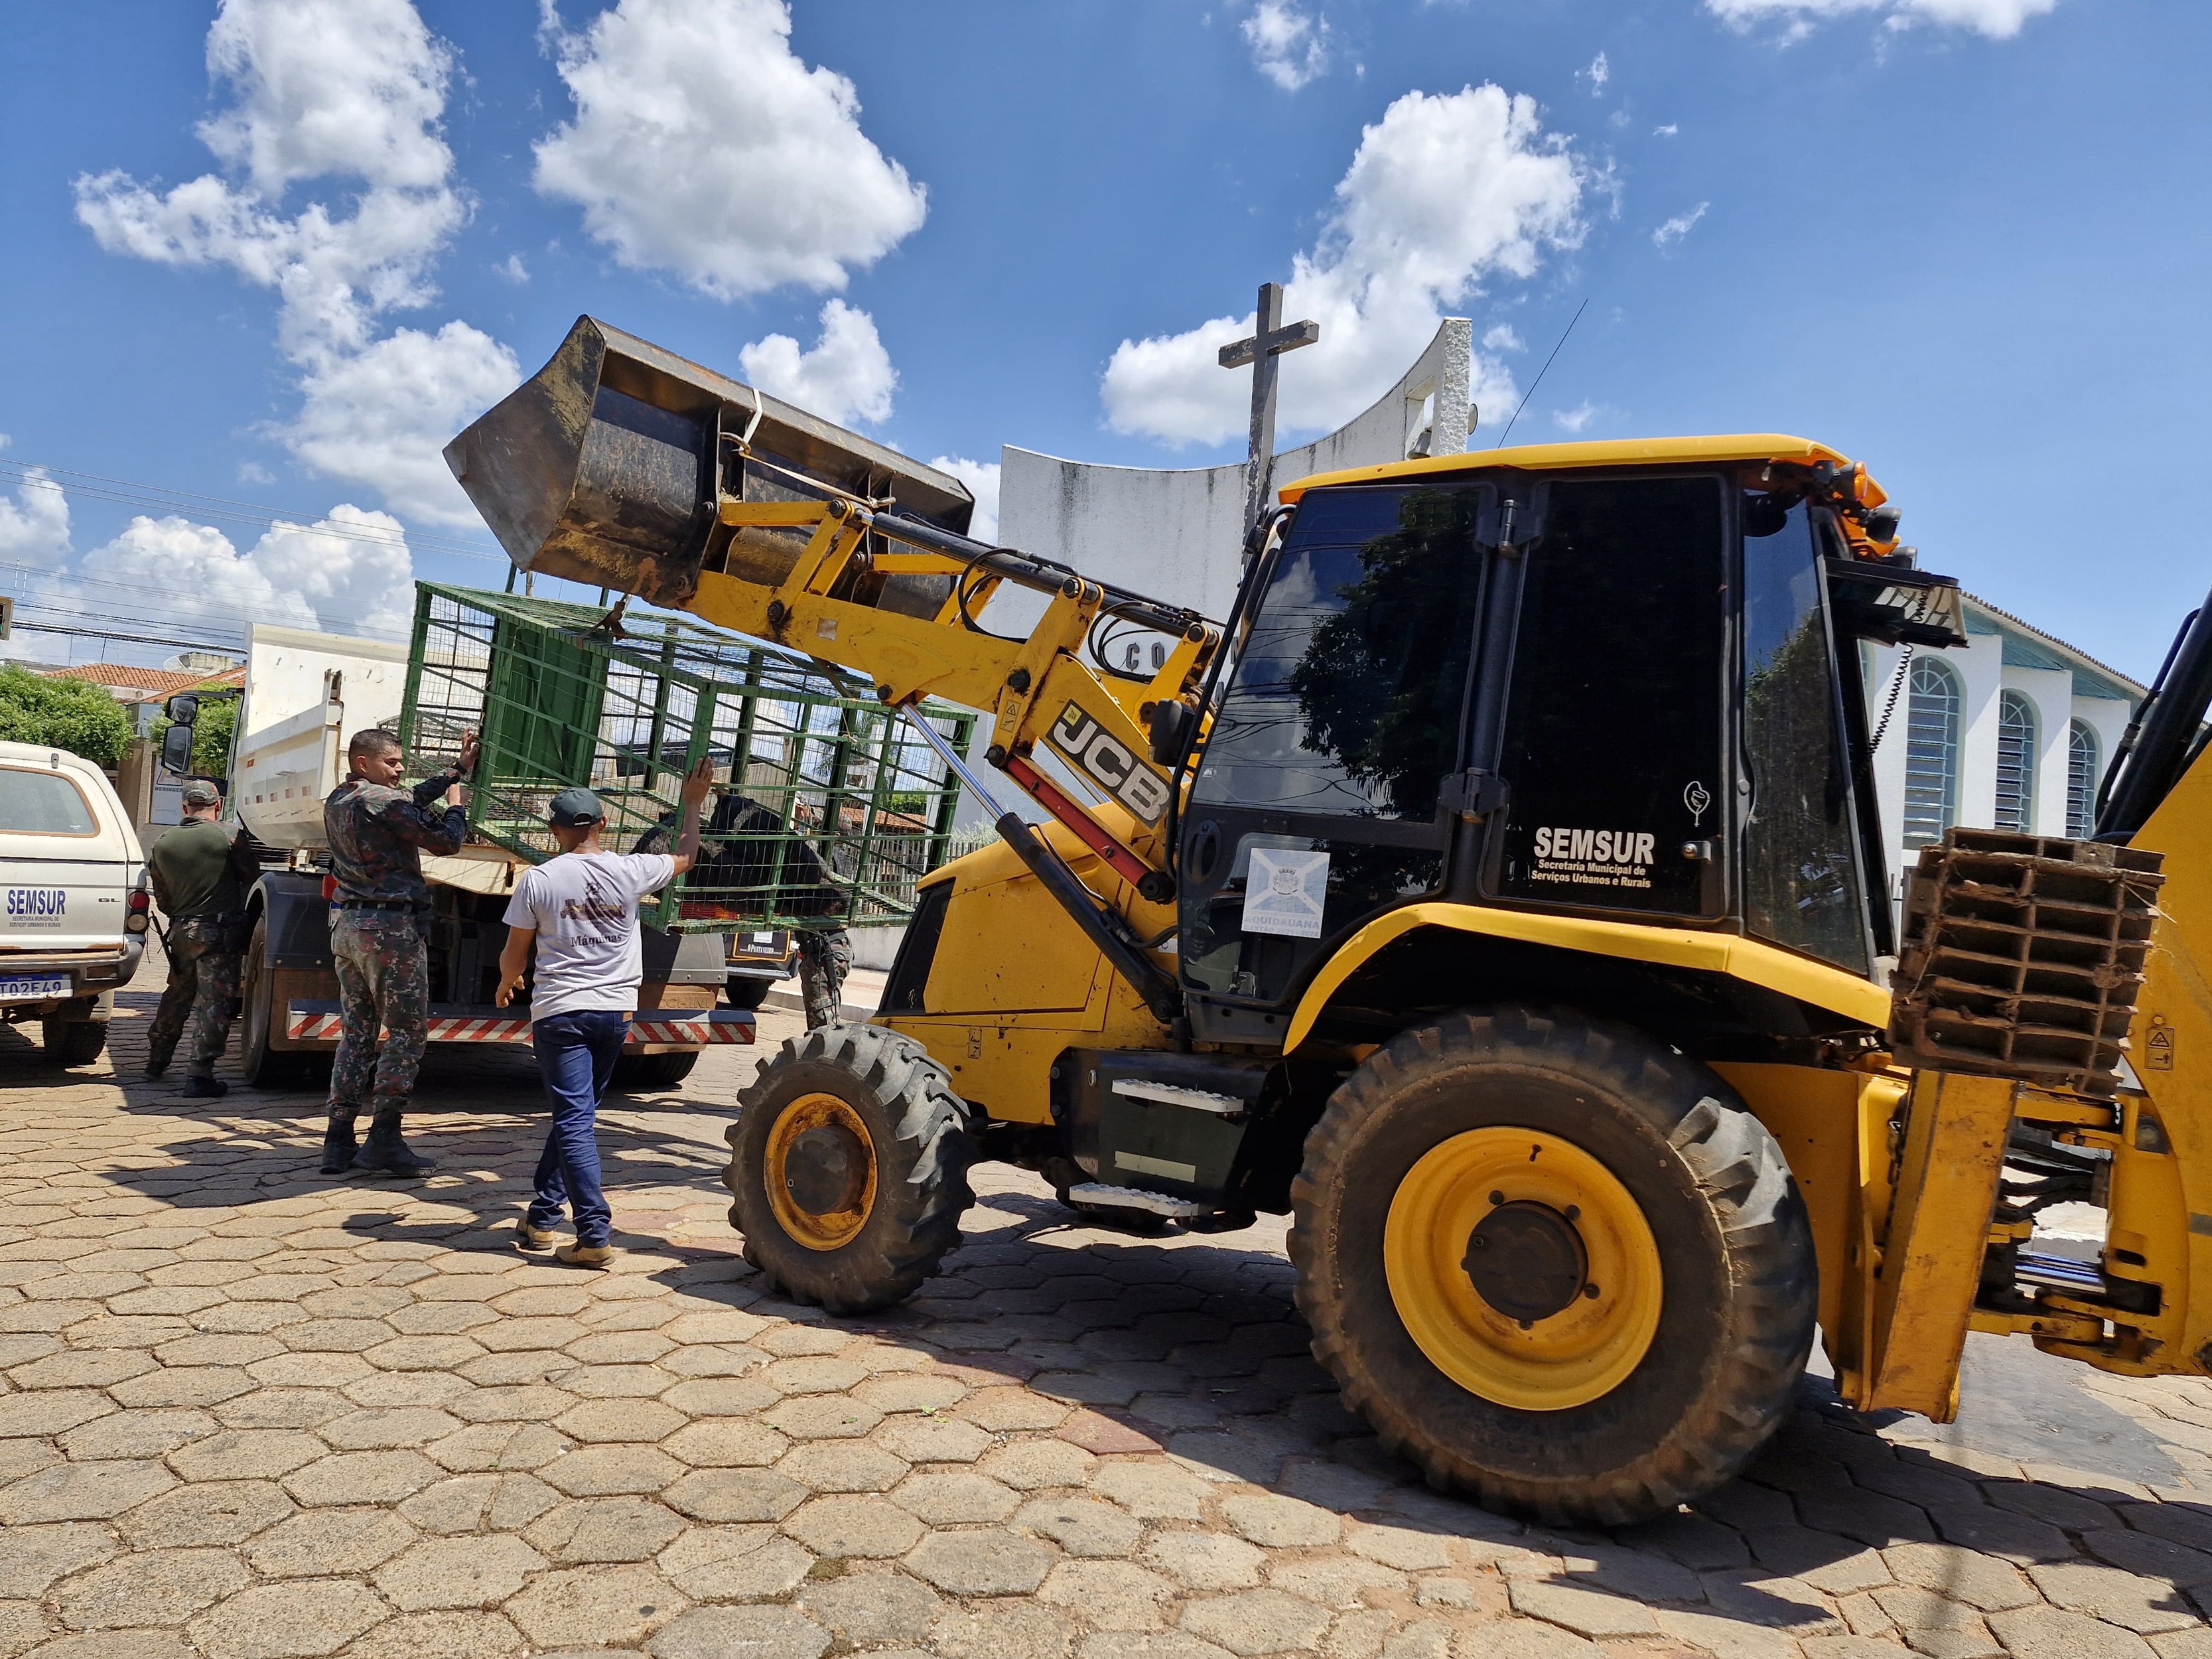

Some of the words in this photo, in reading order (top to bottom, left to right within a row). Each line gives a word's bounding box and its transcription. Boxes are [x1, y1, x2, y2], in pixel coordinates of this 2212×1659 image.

[1054, 720, 1170, 821] JCB
[1533, 827, 1655, 865] SEMSUR
[1538, 859, 1585, 871] Secretaria
[1587, 863, 1632, 876] Municipal
[1633, 866, 1646, 875] de
[1531, 870, 1570, 883] Serviços
[1572, 873, 1610, 885] Urbanos
[1621, 877, 1651, 888] Rurais
[7, 890, 65, 914] SEMSUR
[1245, 916, 1320, 930] AQUIDAUANA
[571, 934, 622, 947] Máquinas
